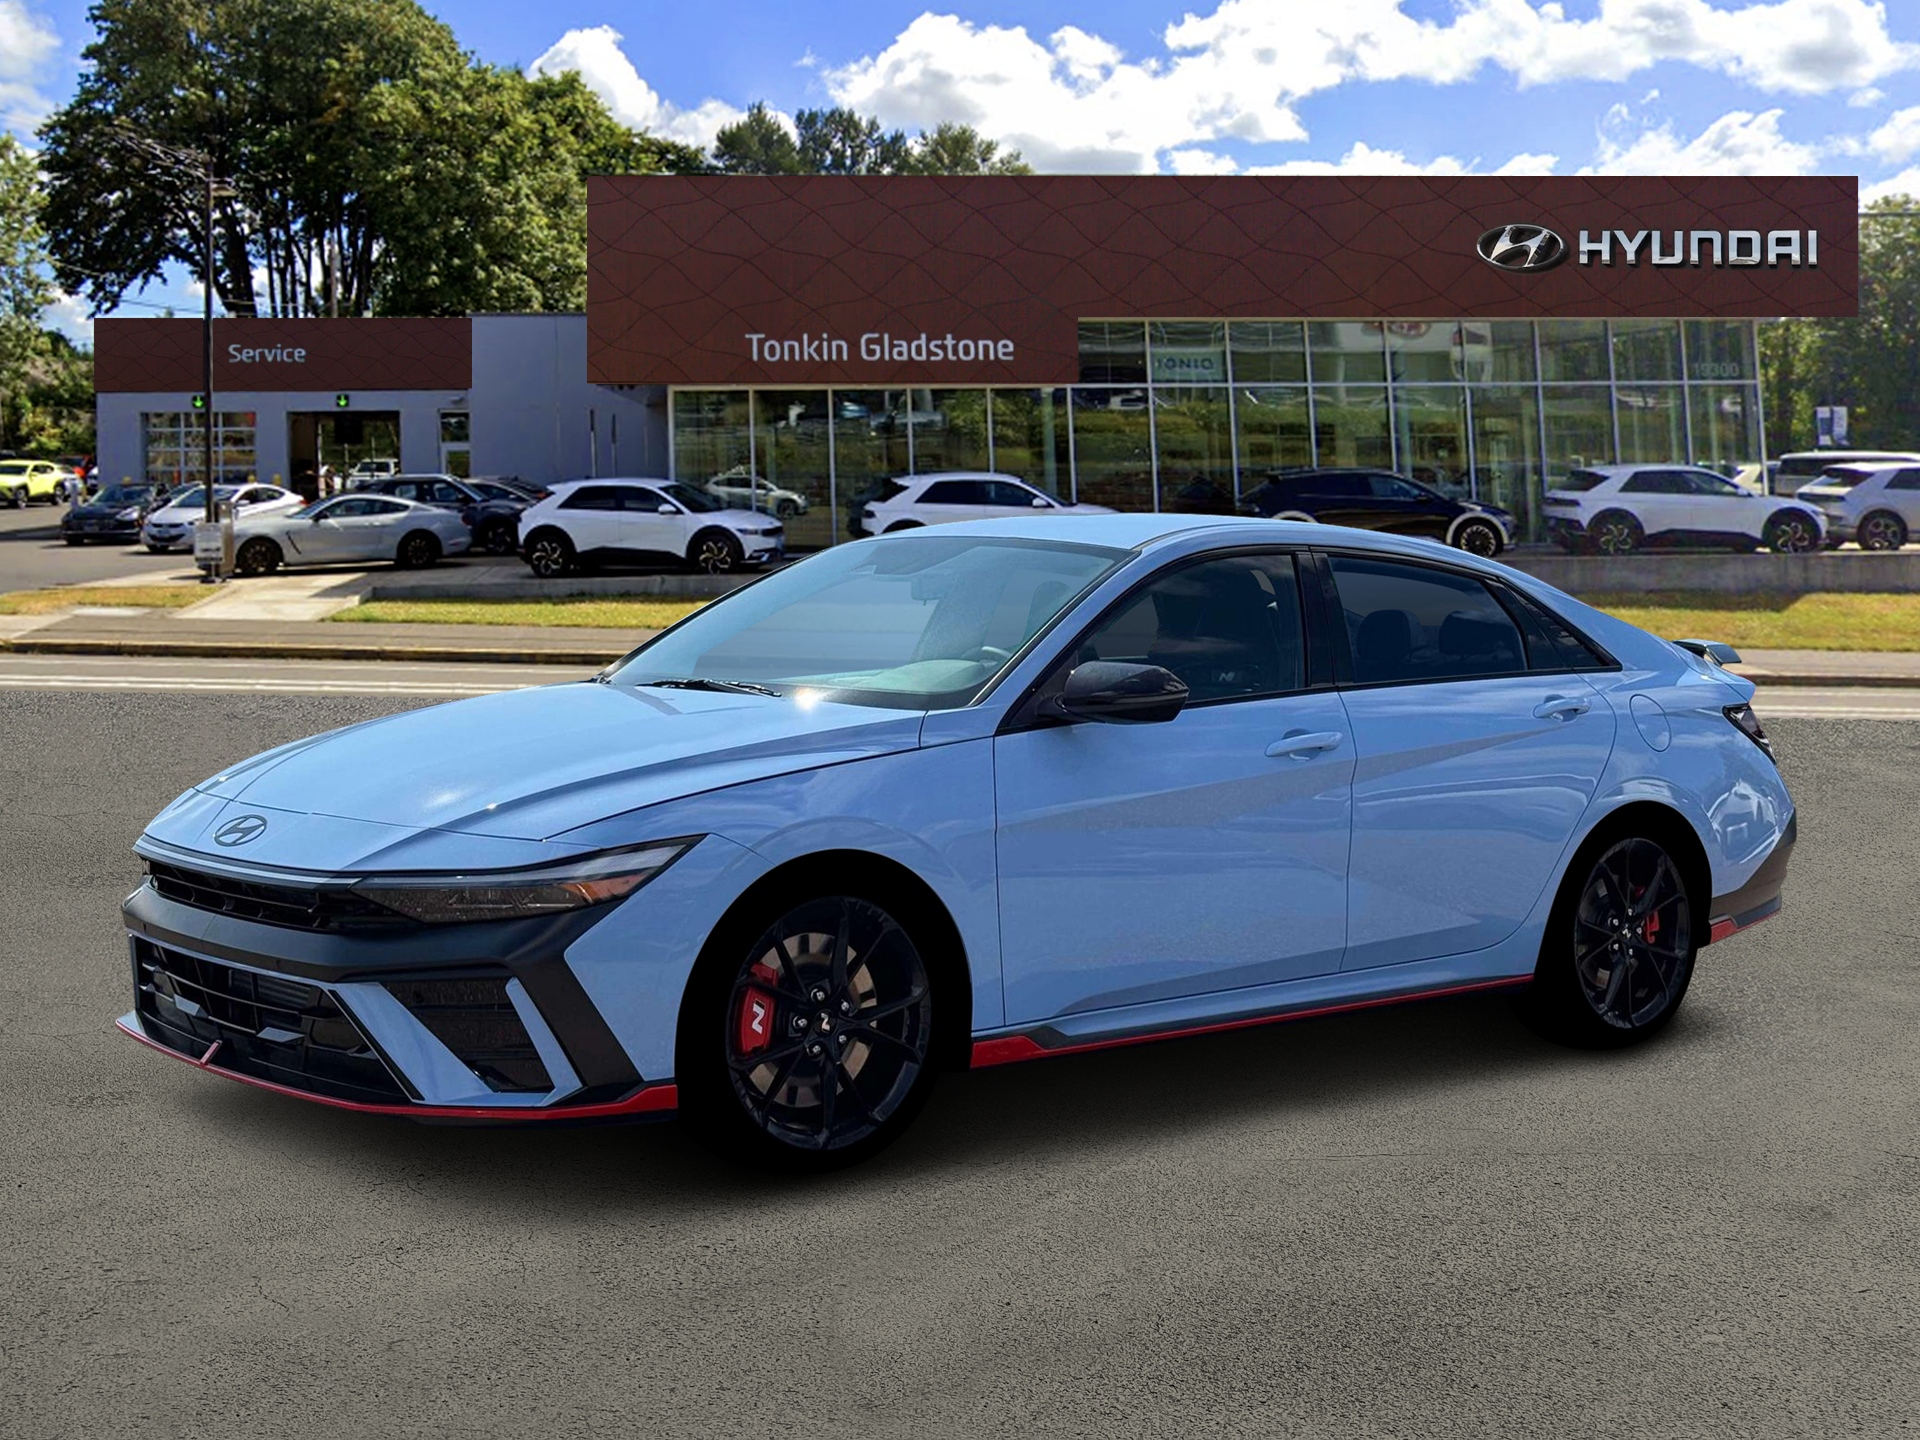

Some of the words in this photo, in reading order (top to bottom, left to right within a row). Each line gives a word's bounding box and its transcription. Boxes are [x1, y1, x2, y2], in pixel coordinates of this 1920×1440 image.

[1579, 230, 1818, 265] HYUNDAI
[227, 343, 307, 363] Service
[744, 333, 848, 362] Tonkin
[860, 333, 1014, 362] Gladstone
